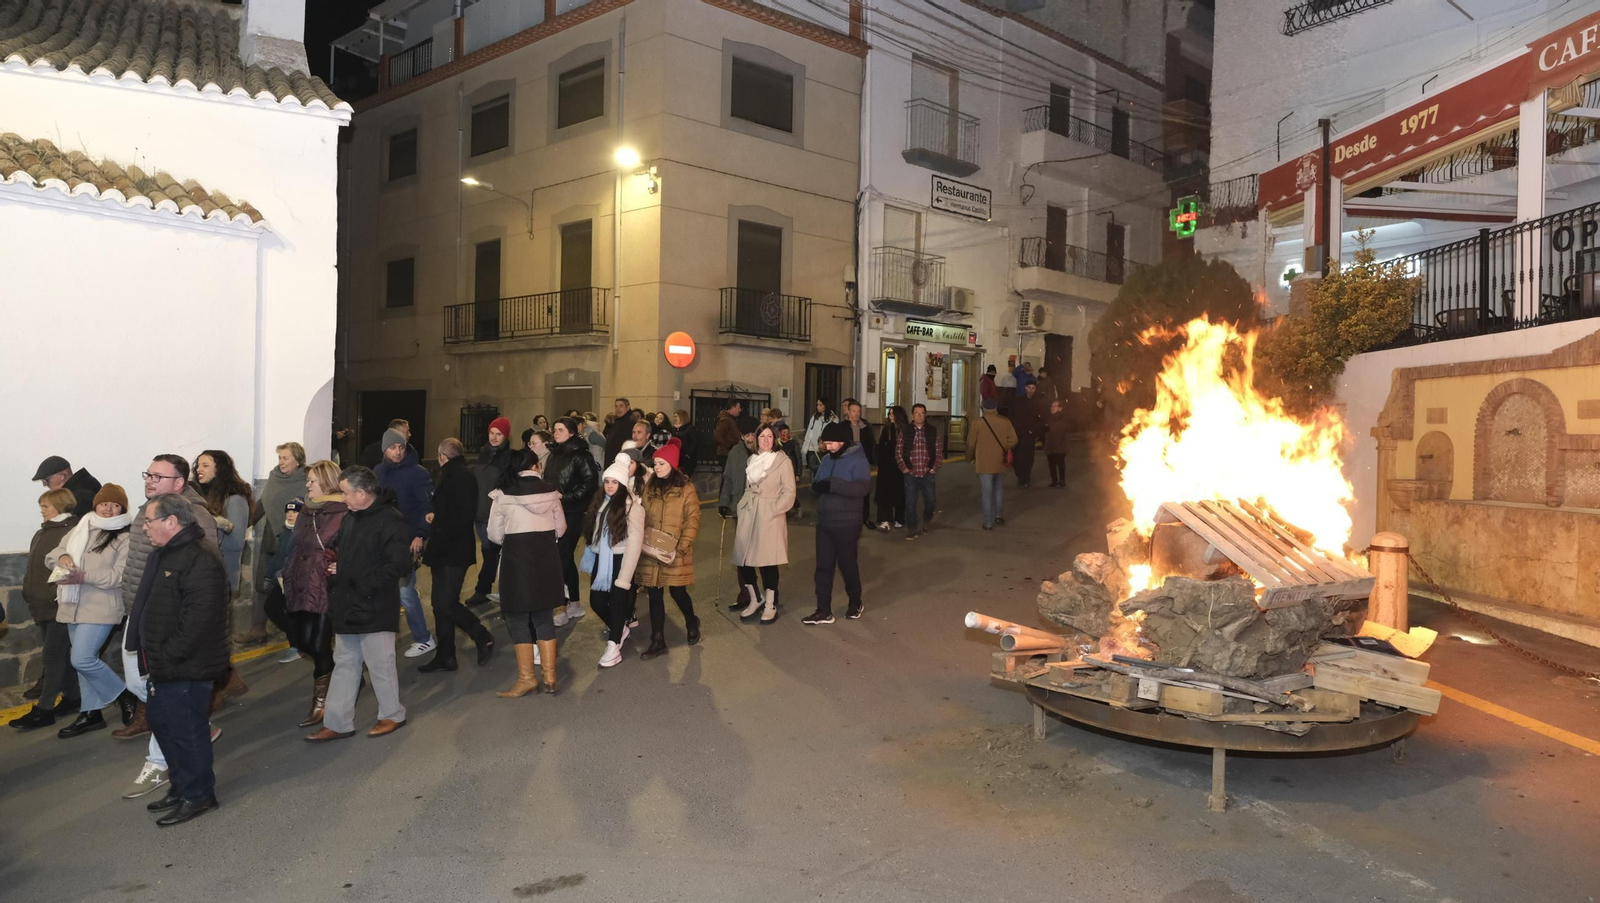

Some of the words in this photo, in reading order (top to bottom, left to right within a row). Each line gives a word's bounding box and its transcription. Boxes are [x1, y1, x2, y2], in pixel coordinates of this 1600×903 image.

[1538, 23, 1600, 71] CAF
[1334, 134, 1377, 164] Desde
[1400, 103, 1439, 136] 1977
[936, 181, 987, 204] Restaurante
[906, 324, 934, 338] CAFE-BAR
